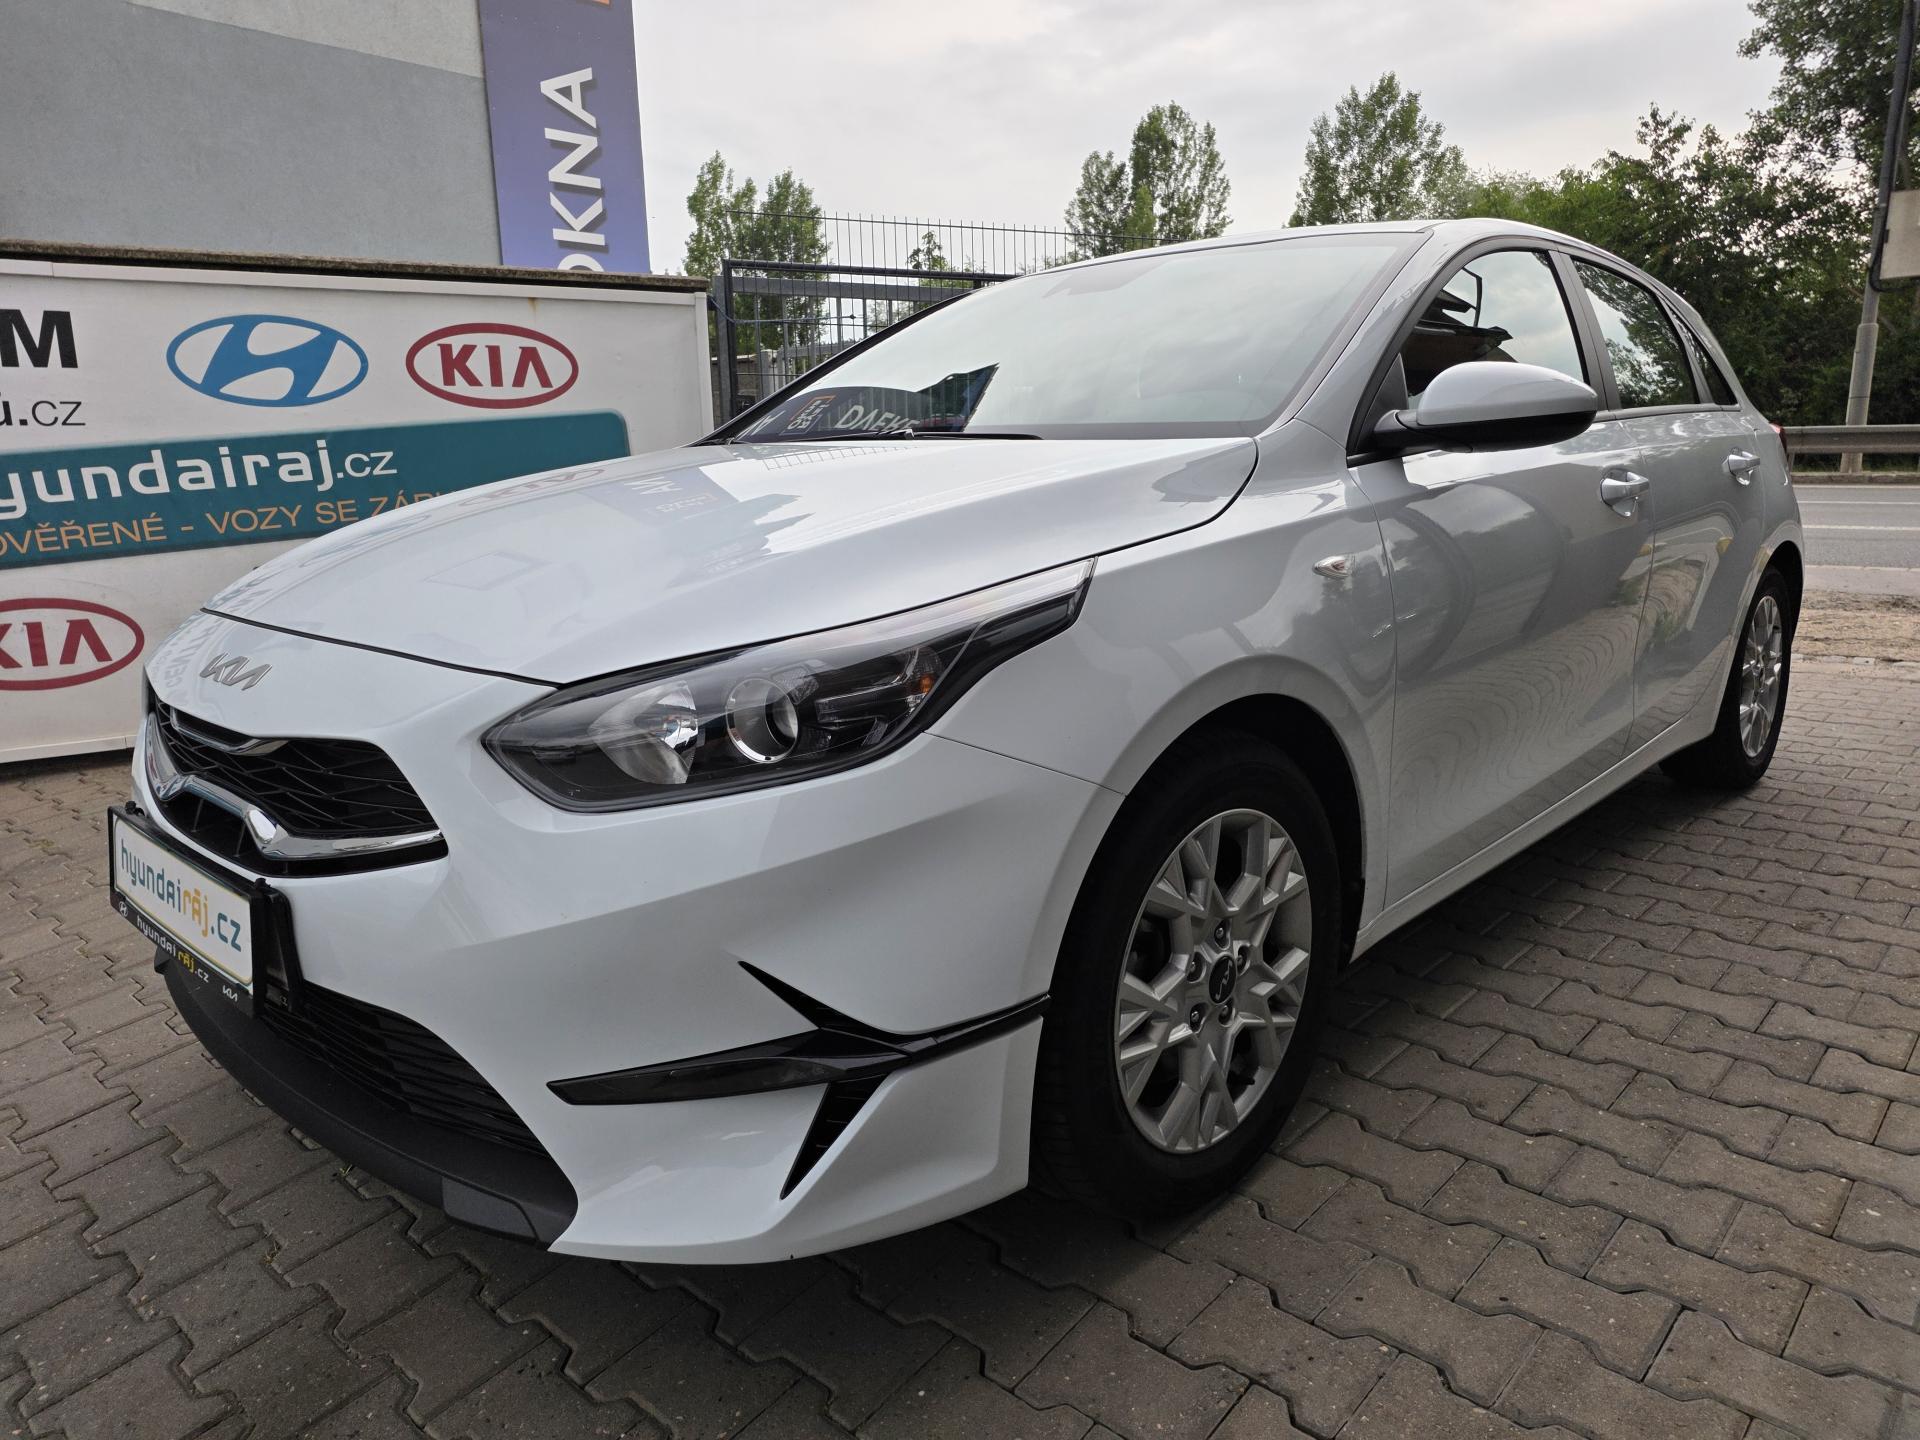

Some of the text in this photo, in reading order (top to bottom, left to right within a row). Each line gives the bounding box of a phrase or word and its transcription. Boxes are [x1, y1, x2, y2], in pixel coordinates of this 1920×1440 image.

[437, 343, 554, 388] KIA
[0, 512, 168, 557] VĚŘENÉ
[206, 504, 303, 535] VOZY
[315, 499, 360, 525] SE
